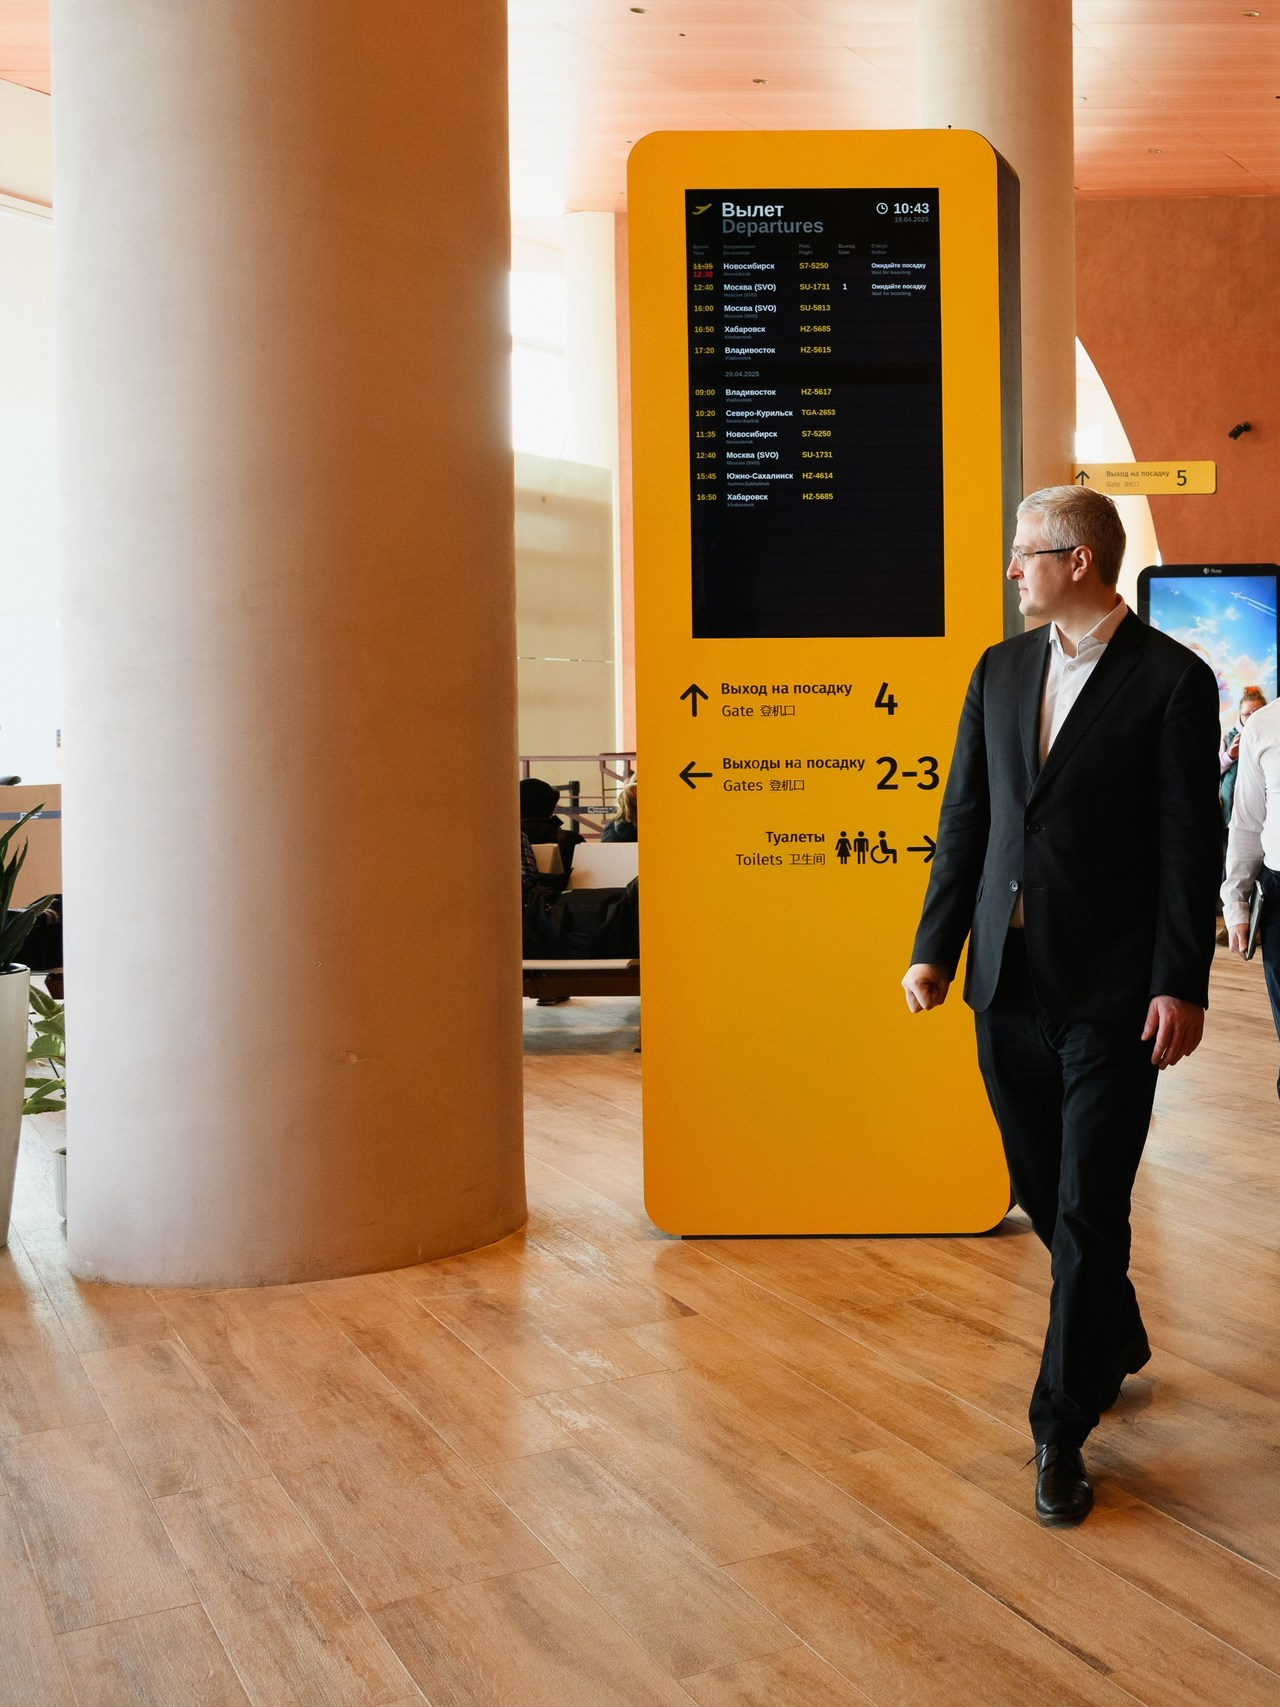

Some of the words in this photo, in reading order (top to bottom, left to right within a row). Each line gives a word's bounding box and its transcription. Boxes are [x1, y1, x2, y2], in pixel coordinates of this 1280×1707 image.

[722, 203, 784, 217] Вылет
[894, 203, 929, 214] 10:43
[722, 219, 824, 237] Departures
[902, 262, 926, 270] посадку
[754, 283, 776, 292] (SVO)
[902, 283, 926, 291] посадку
[754, 305, 777, 313] (SVO)
[724, 326, 766, 334] Хабаровск
[725, 347, 776, 355] Владивосток
[725, 389, 776, 397] Владивосток
[726, 410, 793, 418] Северо-Курильск
[726, 431, 778, 439] Новосибирск
[726, 451, 755, 459] Москва
[757, 451, 779, 460] (SVO)
[726, 472, 794, 480] Южно-Сахалинск
[1106, 470, 1129, 478] Выход
[1176, 469, 1187, 487] 5
[727, 493, 768, 502] Хабаровск
[721, 683, 768, 696] Выход
[771, 684, 790, 695] на
[793, 683, 853, 696] посадку
[874, 681, 898, 716] 4
[721, 705, 754, 717] Gate
[760, 705, 796, 717] 登机口
[722, 757, 781, 772] Выходы
[785, 759, 802, 769] на
[806, 757, 866, 772] посадку
[875, 755, 940, 791] 2-3
[723, 779, 763, 792] Gates
[769, 779, 805, 792] 登机口
[765, 831, 825, 846] Туалеты
[736, 853, 783, 866] Toilets
[788, 853, 826, 866] 卫生间
